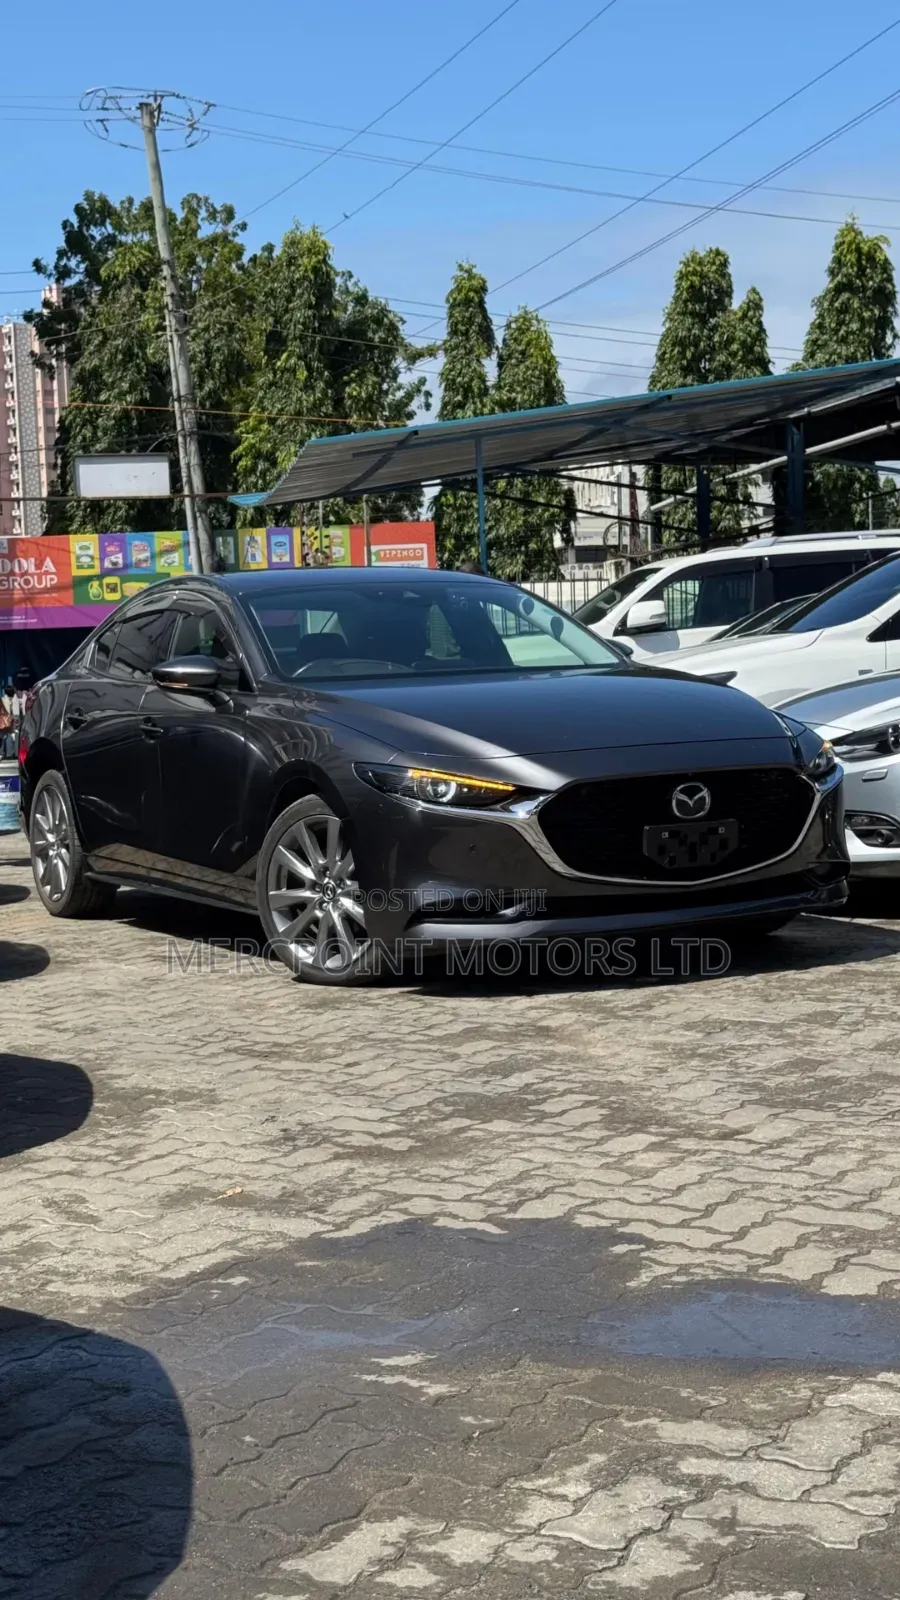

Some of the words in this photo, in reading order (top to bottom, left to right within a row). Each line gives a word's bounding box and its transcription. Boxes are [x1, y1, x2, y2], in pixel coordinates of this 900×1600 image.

[380, 549, 422, 558] VIPINGO
[0, 556, 57, 574] DOLA
[0, 574, 58, 590] GROUP
